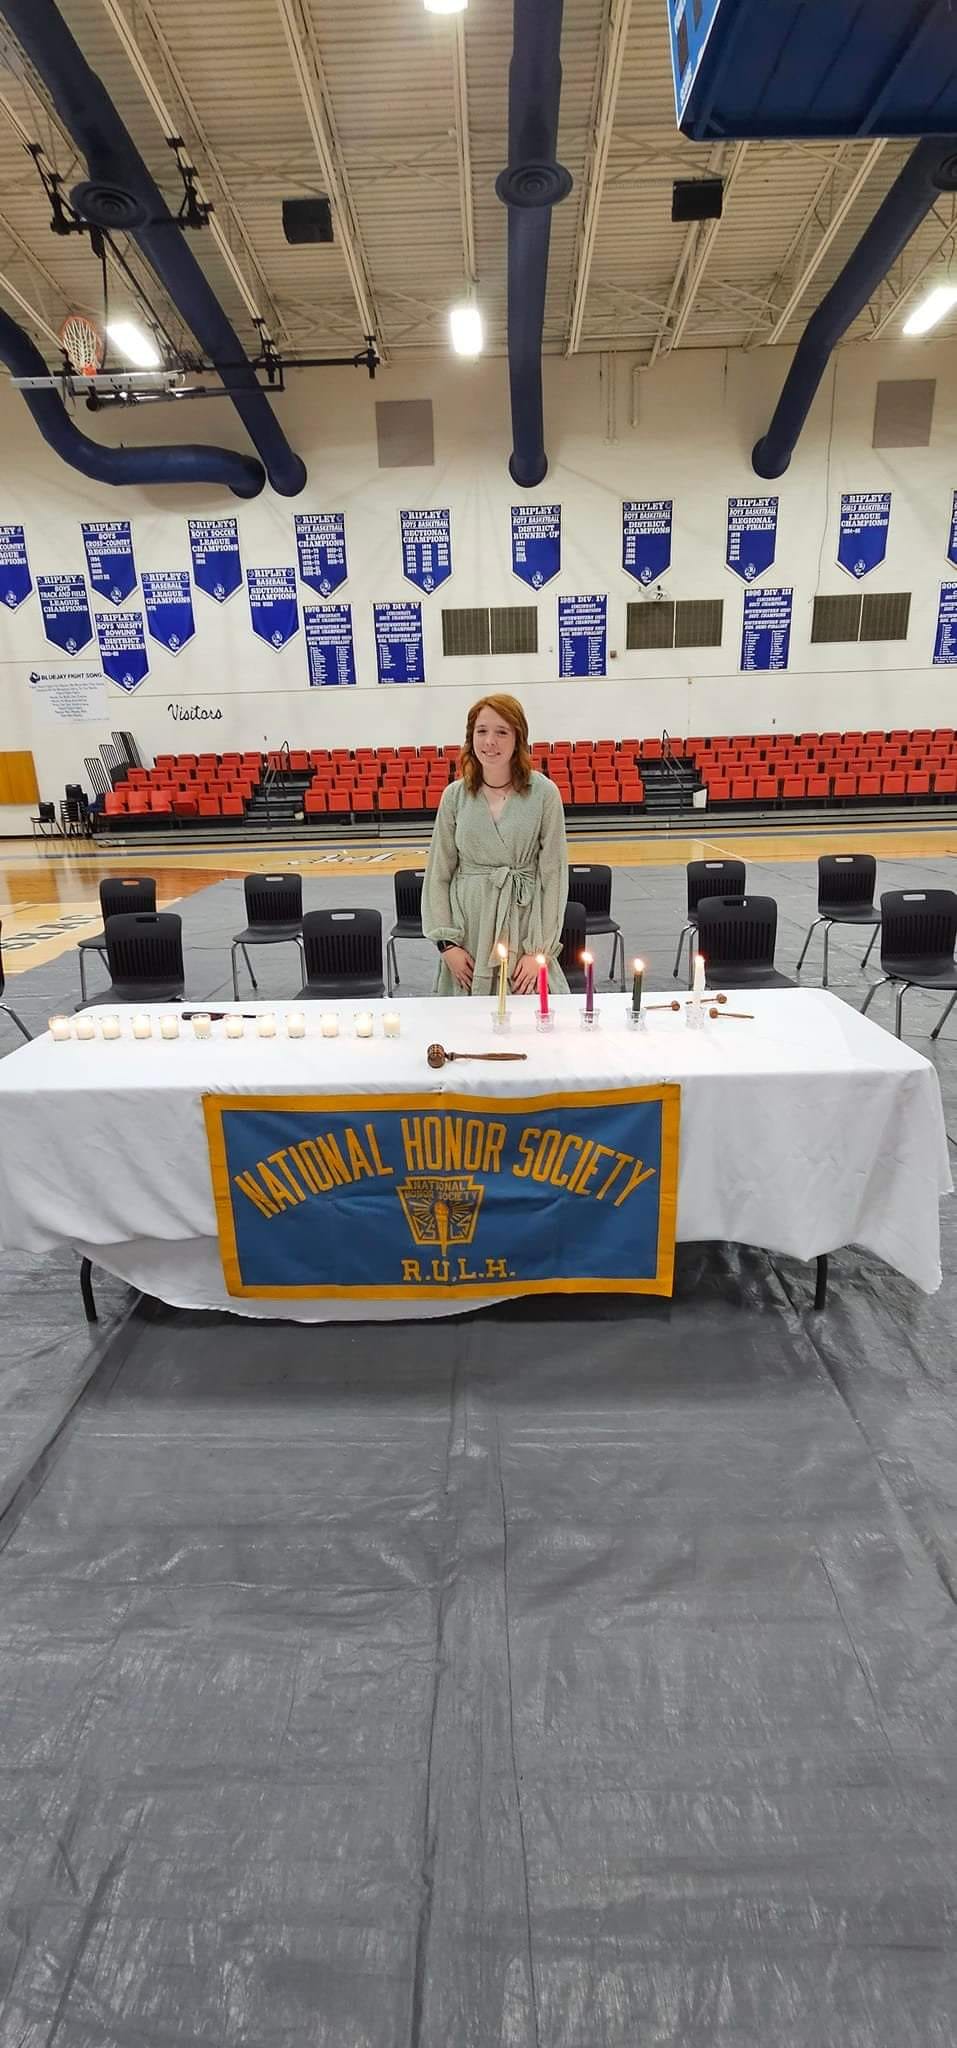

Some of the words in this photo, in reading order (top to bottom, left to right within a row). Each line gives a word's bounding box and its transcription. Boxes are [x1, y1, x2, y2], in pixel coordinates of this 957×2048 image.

[849, 494, 883, 503] RIPLEY
[631, 502, 664, 511] RIPLEY
[736, 499, 770, 507] RIPLEY
[857, 503, 888, 511] BASKETBALL
[519, 506, 552, 515] RIPLEY
[729, 508, 743, 516] BOYS
[745, 506, 776, 515] BASKETBALL
[303, 515, 335, 523] RIPLEY
[408, 511, 441, 519] RIPLEY
[624, 512, 638, 520] BOYS
[640, 511, 670, 519] BASKETBALL
[402, 520, 416, 528] BOYS
[418, 519, 448, 528] BASKETBALL
[512, 516, 527, 524] BOYS
[528, 515, 559, 523] BASKETBALL
[841, 519, 888, 527] CHAMPIONS
[89, 523, 122, 531] RIPLEY
[196, 520, 229, 529] RIPLEY
[312, 524, 343, 532] BASKETBALL
[728, 523, 775, 531] SEMI-FINALIST
[0, 527, 15, 535] LEY
[404, 529, 447, 537] SECTIONAL
[518, 525, 555, 533] DISTRICT
[624, 527, 670, 535] CHAMPIONS
[305, 533, 337, 541] LEAGUE
[513, 531, 559, 540] RUNNER-UP
[85, 539, 130, 547] CROSS-COUNTRY
[298, 540, 344, 548] CHAMPIONS
[88, 547, 131, 555] REGIONALS
[192, 544, 238, 552] CHAMPIONS
[0, 551, 19, 559] AGUE
[149, 573, 182, 581] RIPLEY
[255, 569, 287, 577] RIPLEY
[250, 593, 296, 601] CHAMPIONS
[44, 605, 88, 613] CHAMPIONS
[167, 704, 223, 720] Visitors
[234, 1123, 394, 1219] NATIONAL
[401, 1116, 507, 1173] HONOR
[512, 1127, 656, 1208] SOCIETY
[413, 1181, 465, 1191] NATIONAL
[404, 1190, 434, 1199] HONOR
[439, 1191, 478, 1200] SOCIETY
[401, 1258, 516, 1282] R.U.L.H.
